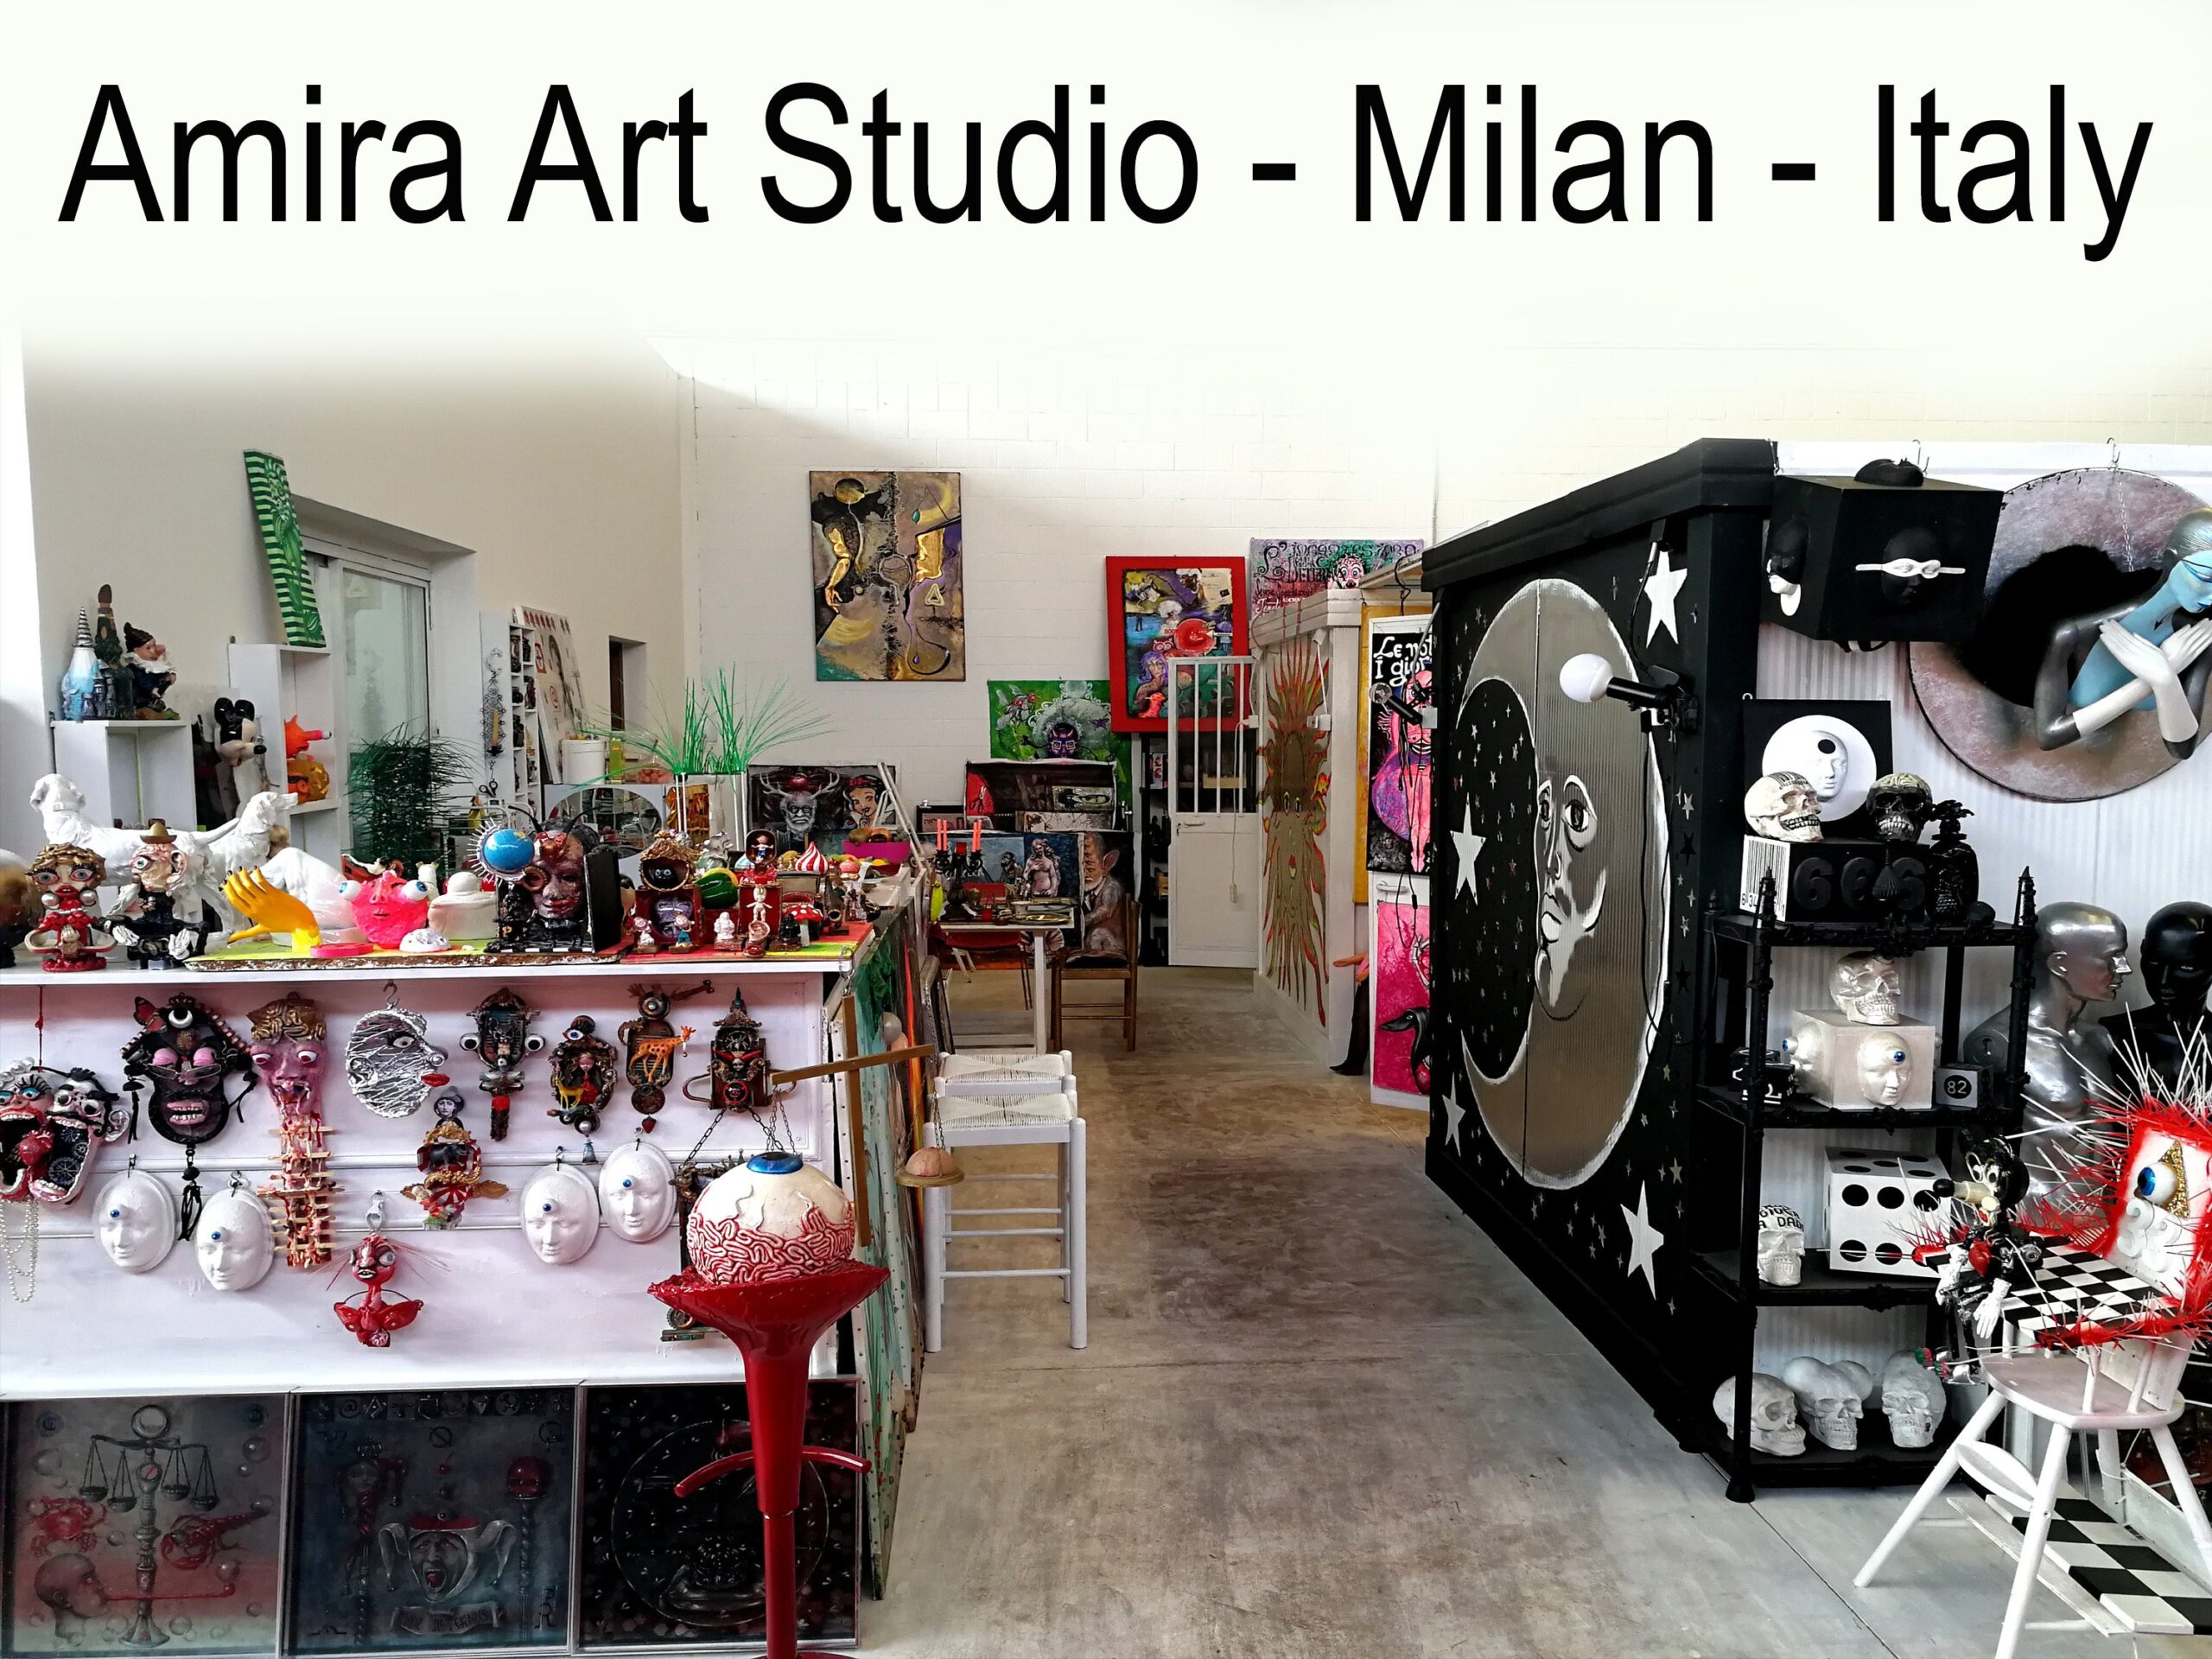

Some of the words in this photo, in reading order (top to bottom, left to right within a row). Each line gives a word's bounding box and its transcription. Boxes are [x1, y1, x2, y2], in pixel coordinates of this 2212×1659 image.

[1373, 636, 1403, 658] Le
[1793, 856, 1927, 910] 666
[1947, 1080, 1967, 1095] 82
